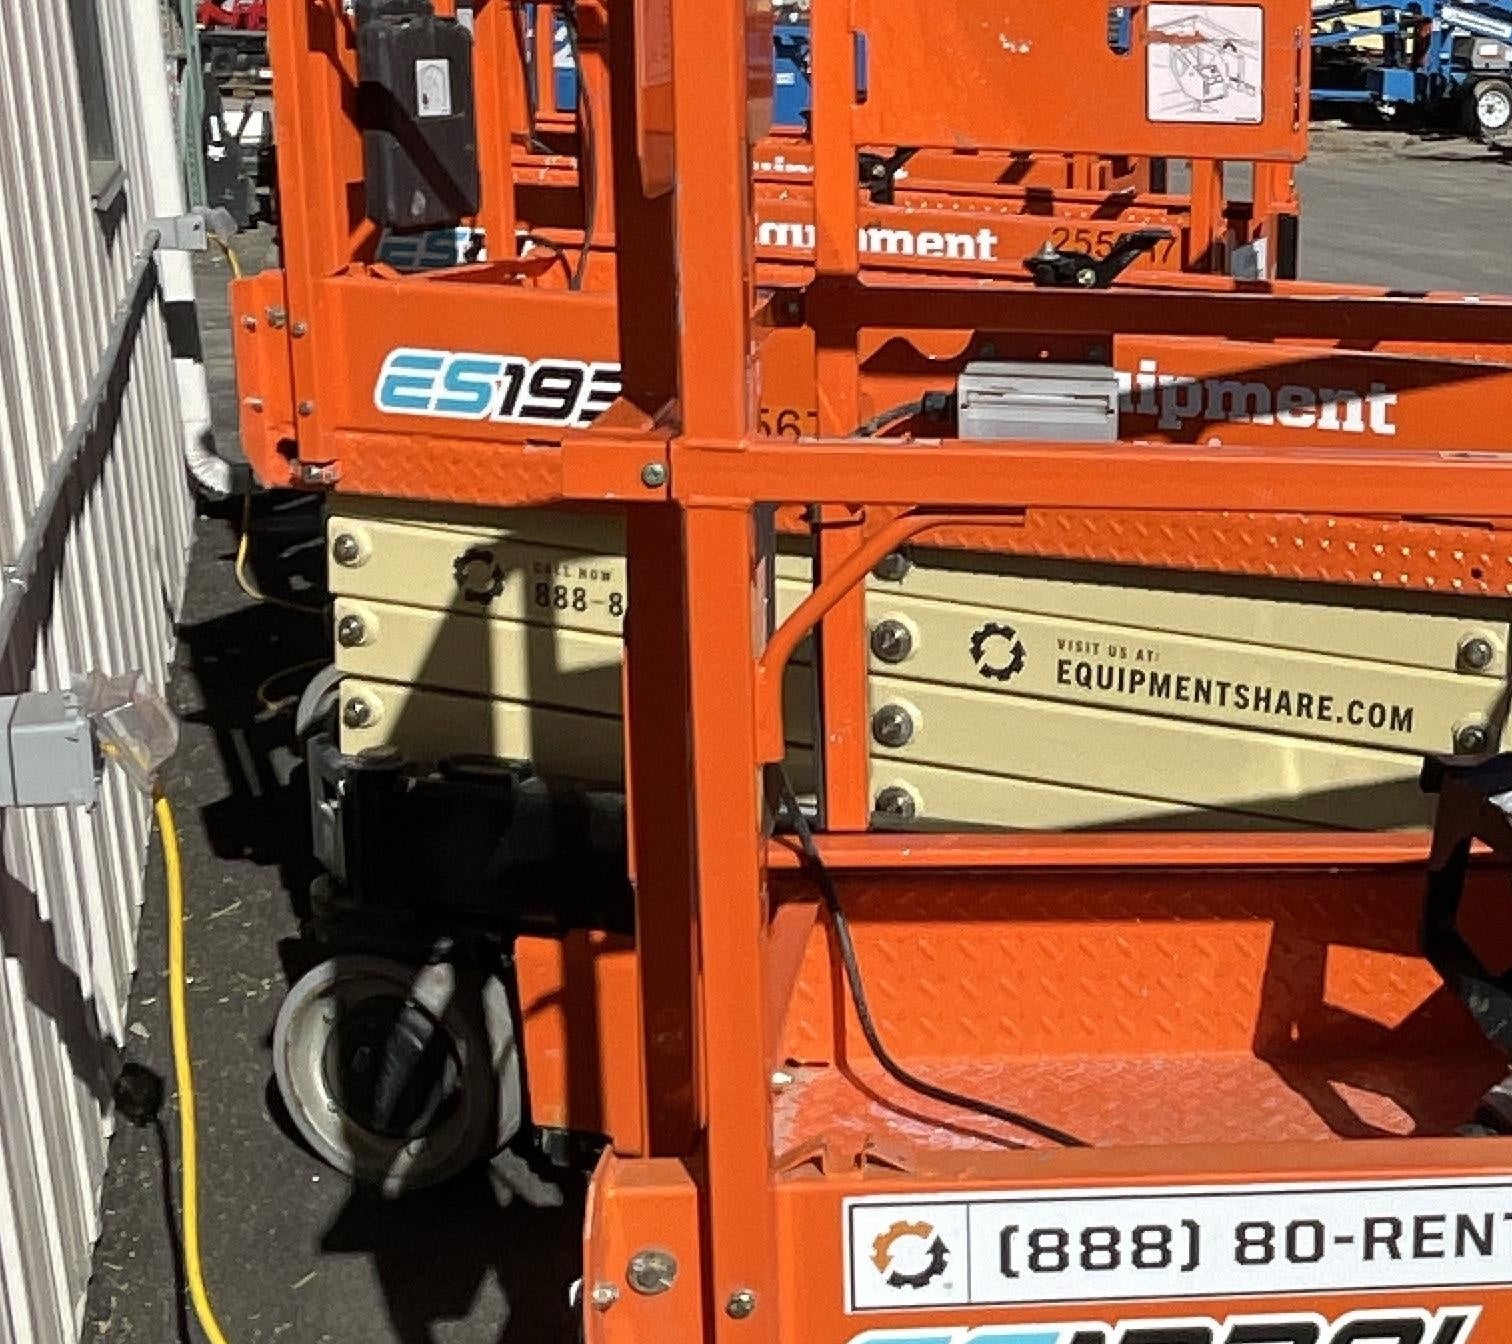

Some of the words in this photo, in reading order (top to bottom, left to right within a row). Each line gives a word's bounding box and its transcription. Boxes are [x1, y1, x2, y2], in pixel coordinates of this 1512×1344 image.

[1057, 638, 1101, 656] VISIT
[1108, 645, 1128, 660] US
[1056, 659, 1414, 733] EQUIPMENTSHARE.COM
